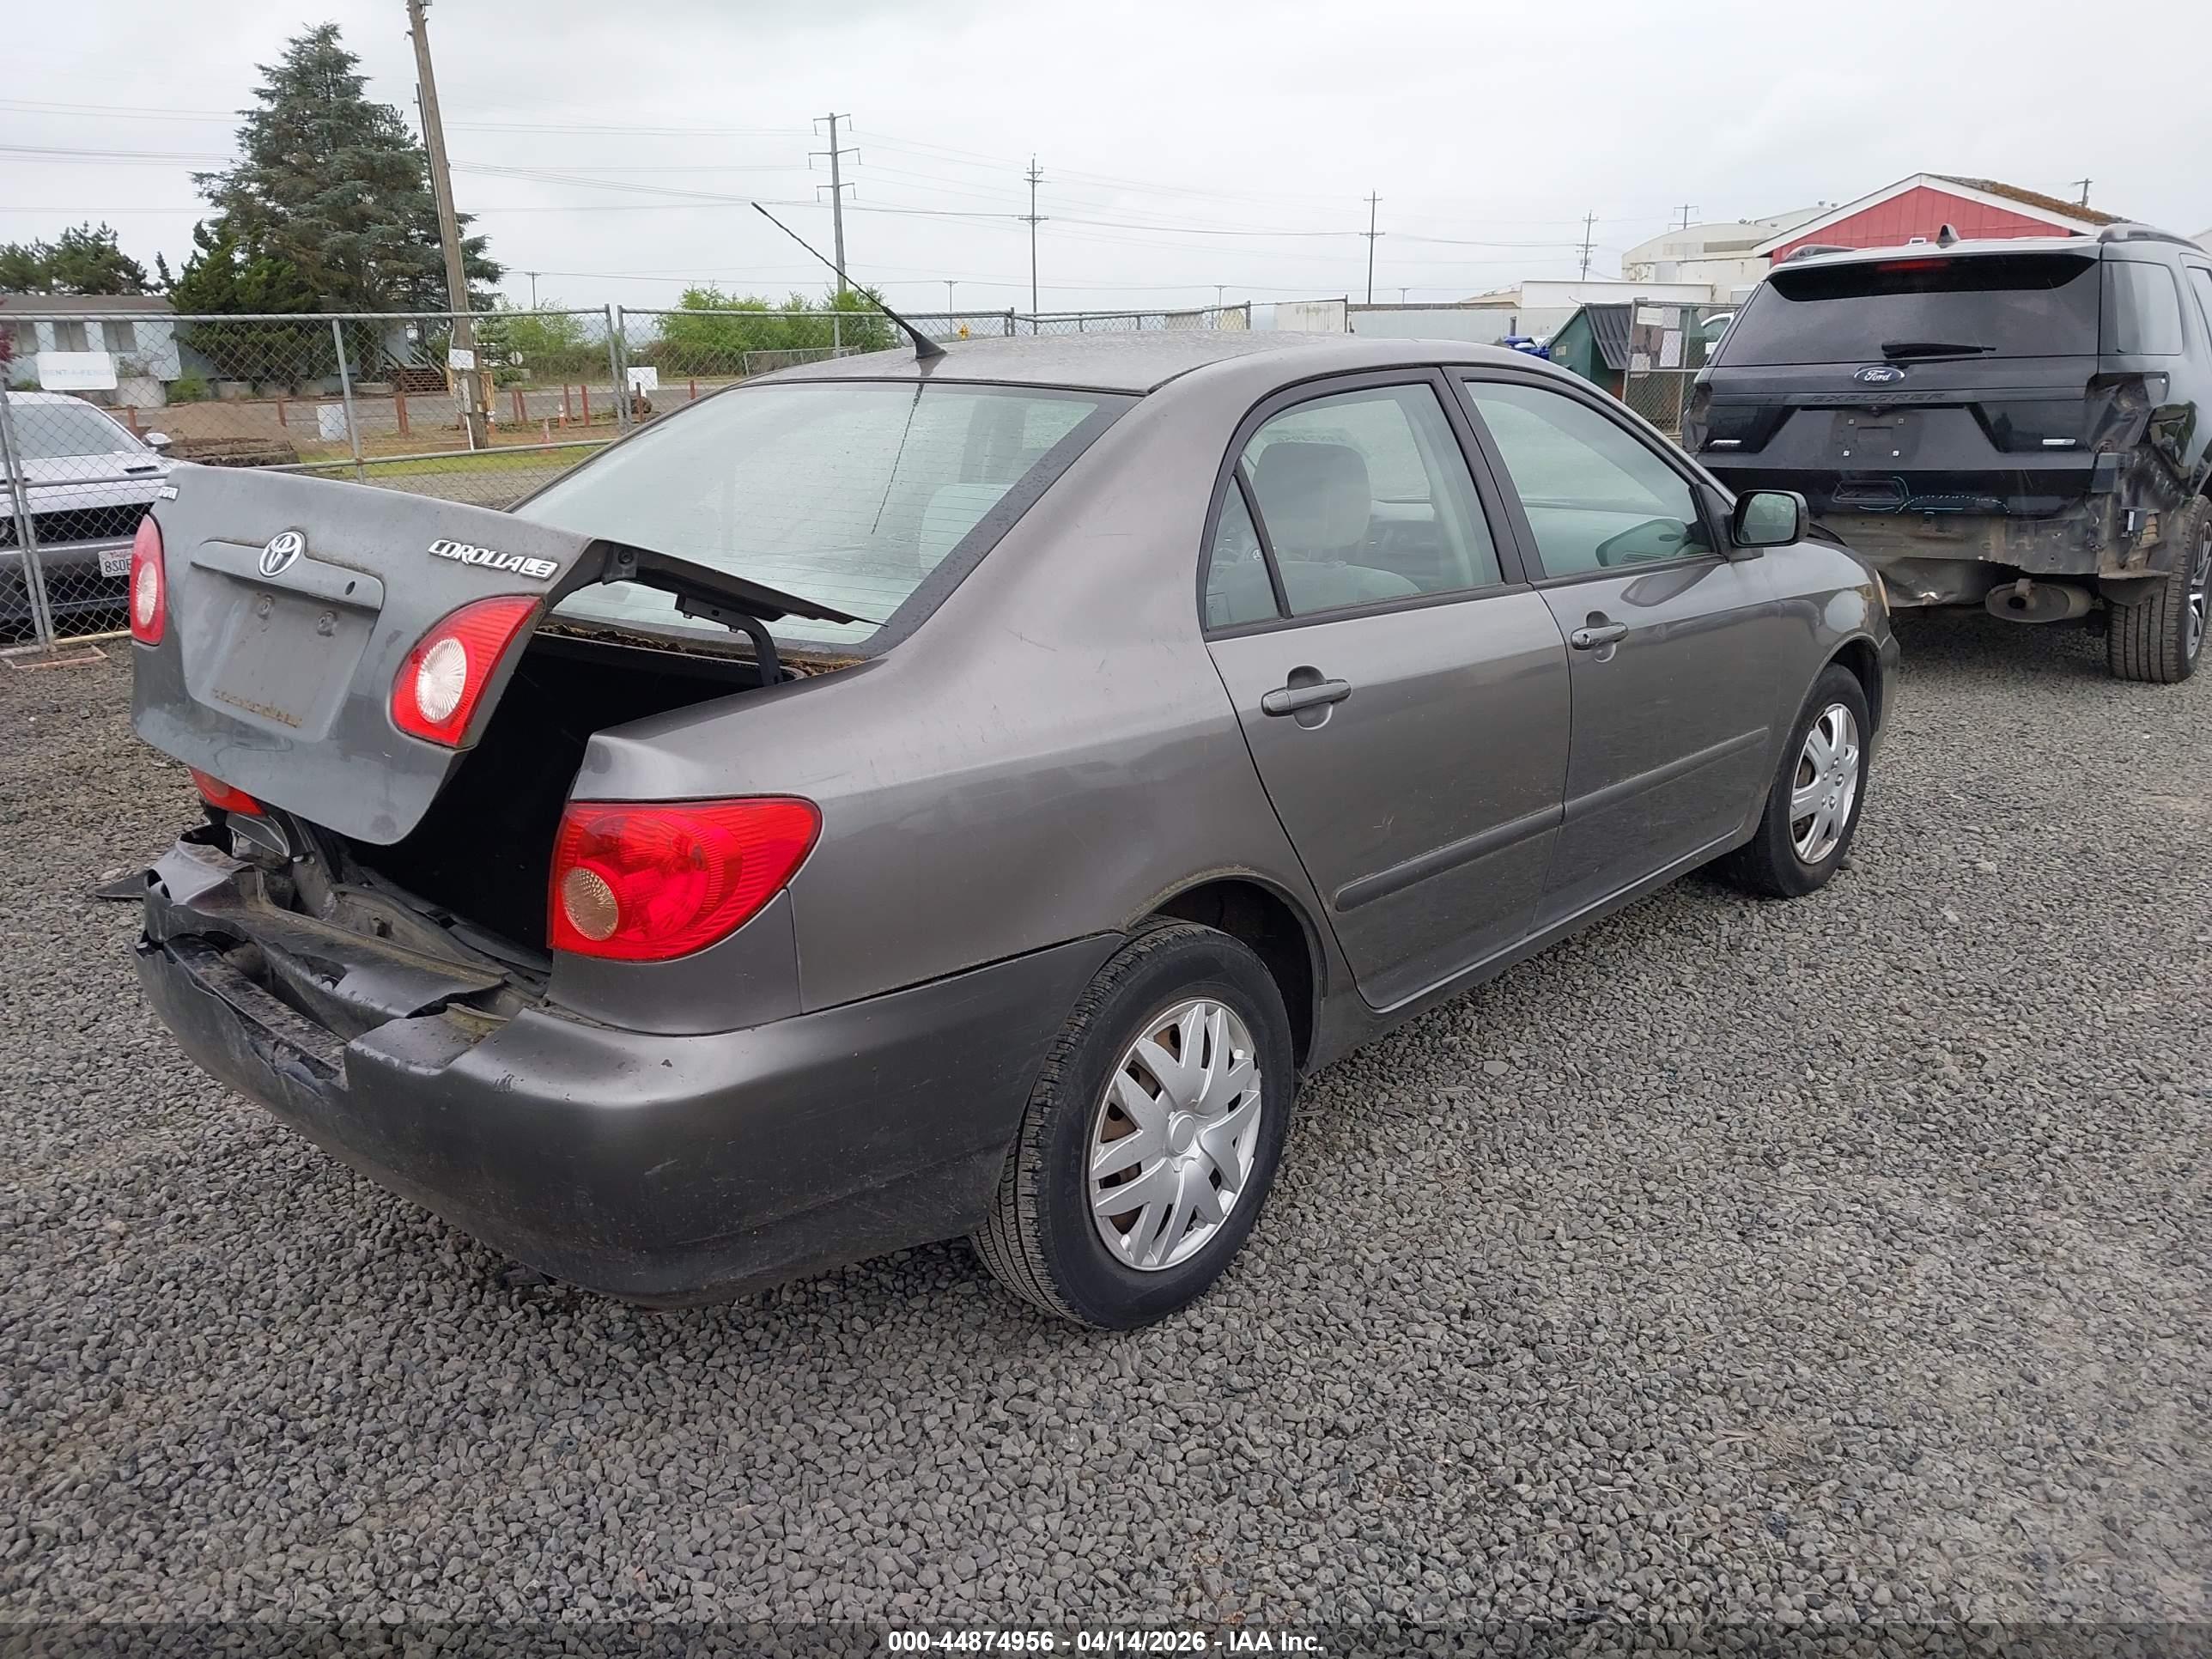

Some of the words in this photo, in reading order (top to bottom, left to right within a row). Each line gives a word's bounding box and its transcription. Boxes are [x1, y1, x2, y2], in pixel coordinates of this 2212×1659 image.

[1864, 369, 1893, 380] Ford
[1810, 392, 1946, 403] EXPLORER
[428, 538, 521, 572] COROLLA
[522, 558, 556, 578] LE
